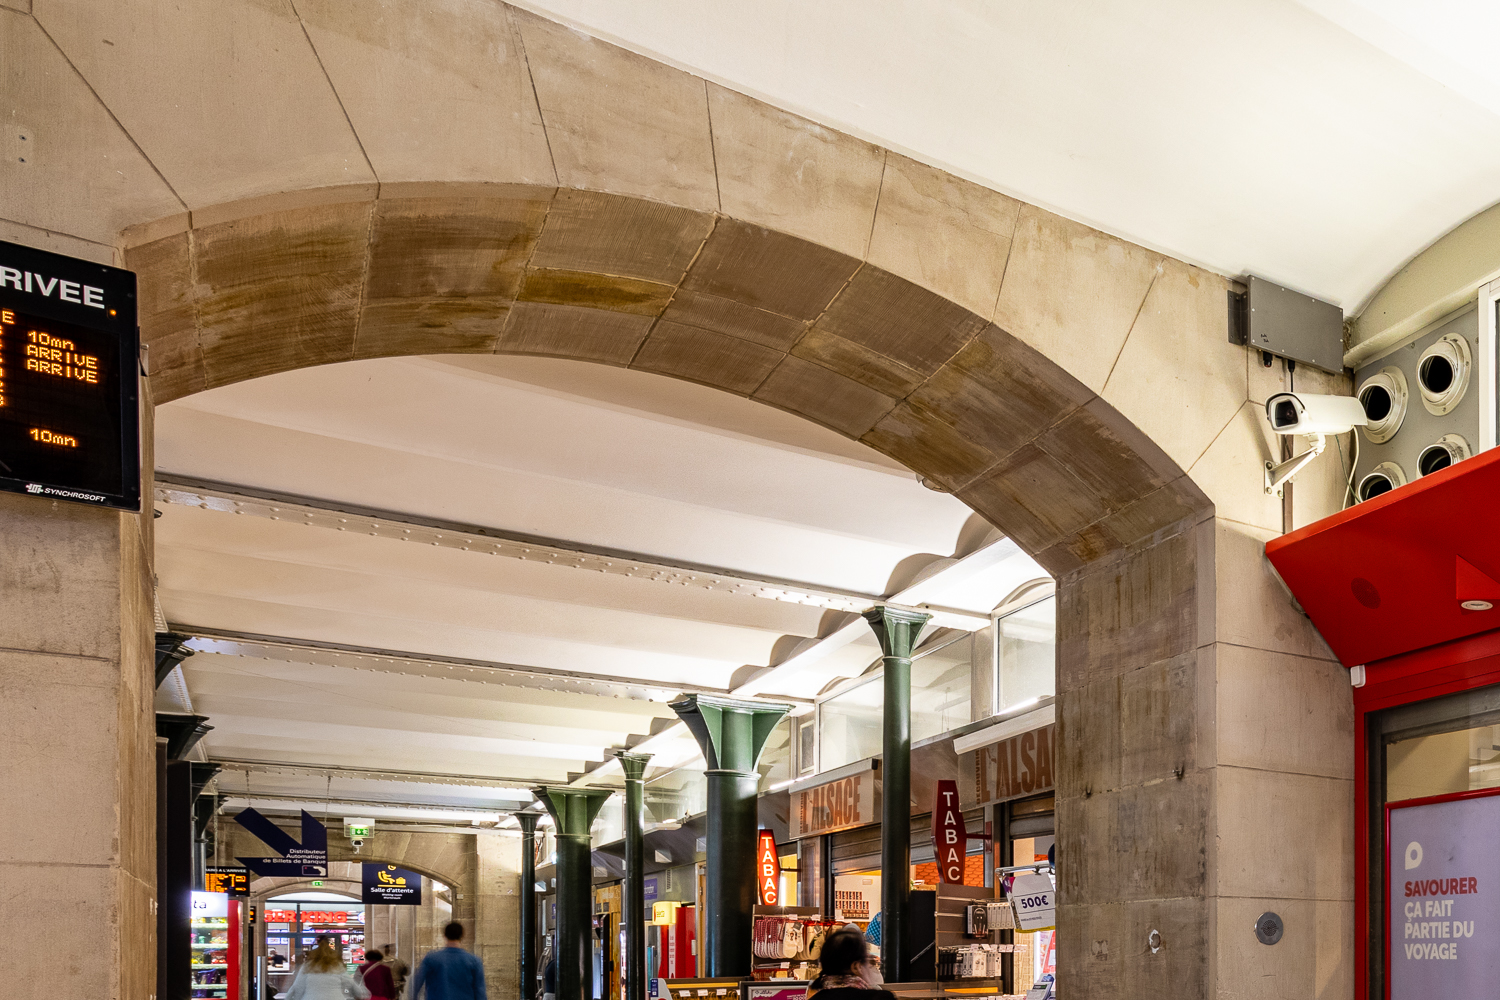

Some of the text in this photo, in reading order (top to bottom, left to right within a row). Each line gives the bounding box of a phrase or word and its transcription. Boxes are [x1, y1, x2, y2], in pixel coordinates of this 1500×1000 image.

[28, 331, 74, 351] 10mn
[27, 345, 98, 369] ARRIVE
[27, 359, 98, 384] ARRIVE
[30, 428, 77, 448] 10mn
[44, 487, 106, 503] SYNCHROSOFT
[942, 791, 961, 881] TABAC
[761, 836, 777, 905] TABAC
[1404, 876, 1478, 897] SAVOURER
[1021, 894, 1049, 909] 500€
[1404, 899, 1454, 922] ÇA FAIT
[300, 910, 348, 924] KING
[1404, 920, 1475, 939] PARTIE DU
[1404, 943, 1458, 960] VOYAGE
